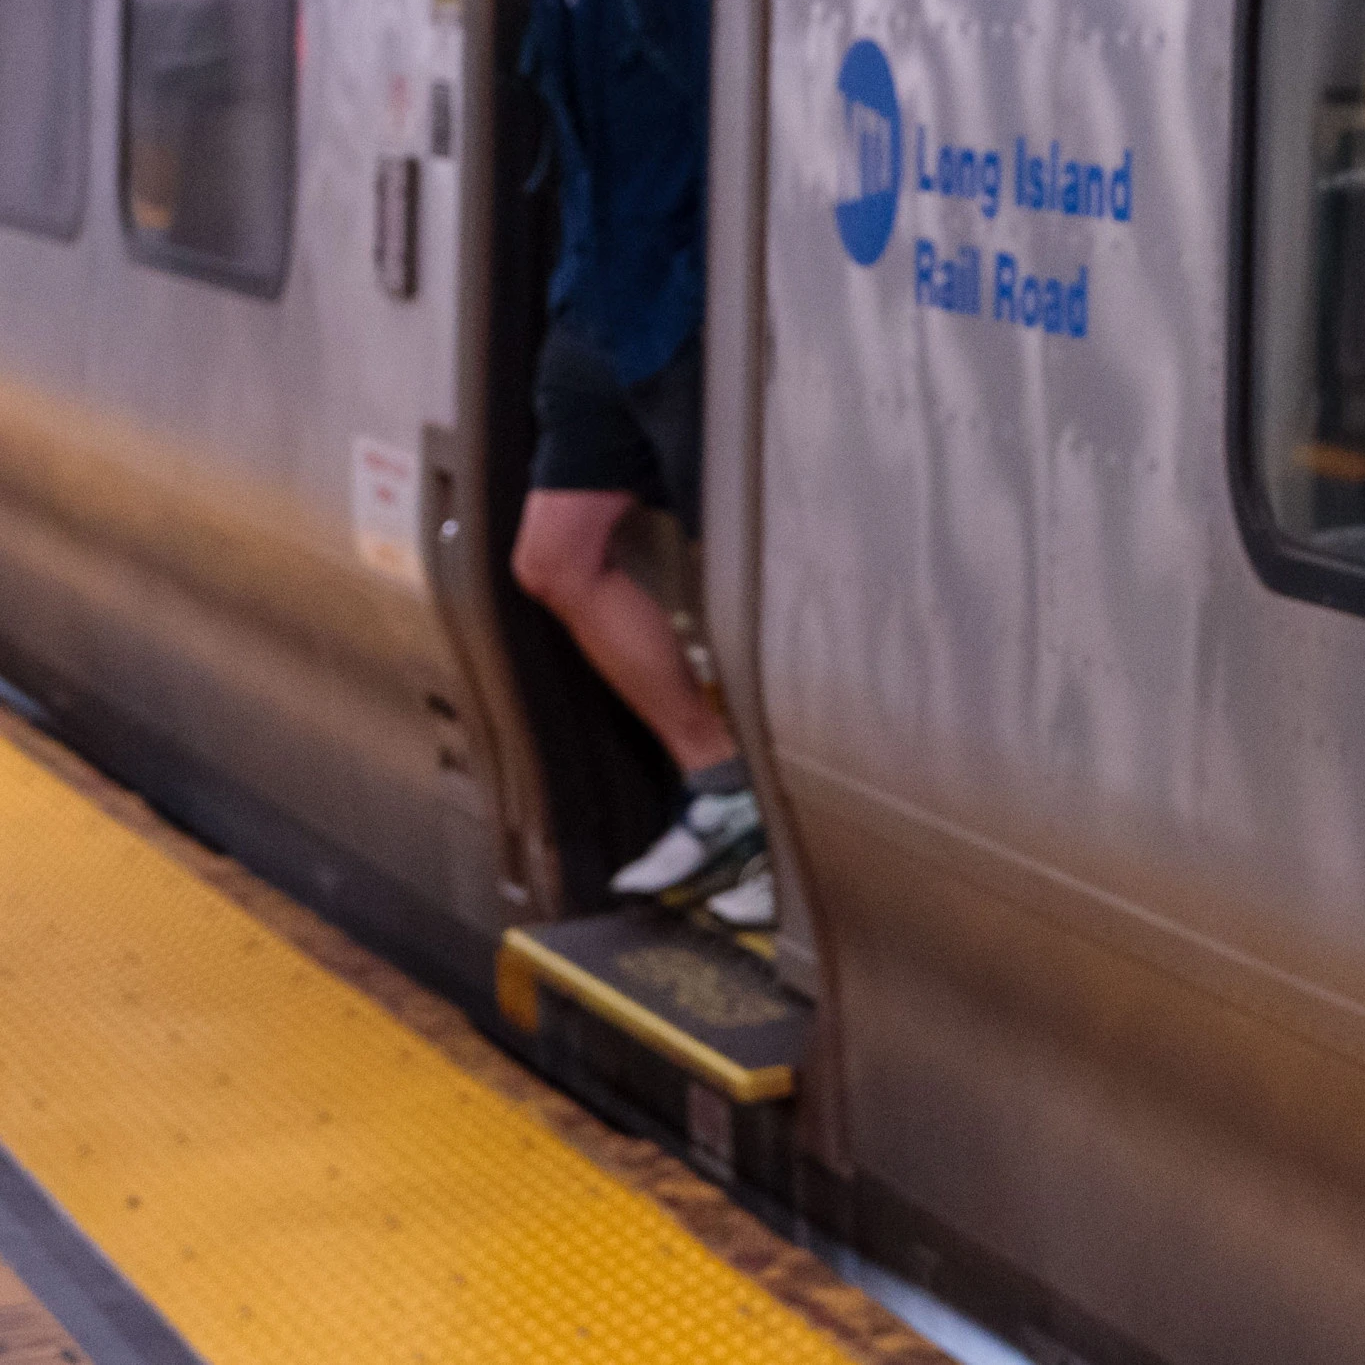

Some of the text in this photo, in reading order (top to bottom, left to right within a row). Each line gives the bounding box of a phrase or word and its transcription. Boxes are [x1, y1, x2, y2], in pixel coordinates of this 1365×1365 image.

[916, 124, 998, 219] Long
[1015, 135, 1132, 222] Island
[915, 238, 1089, 338] Rail Road
